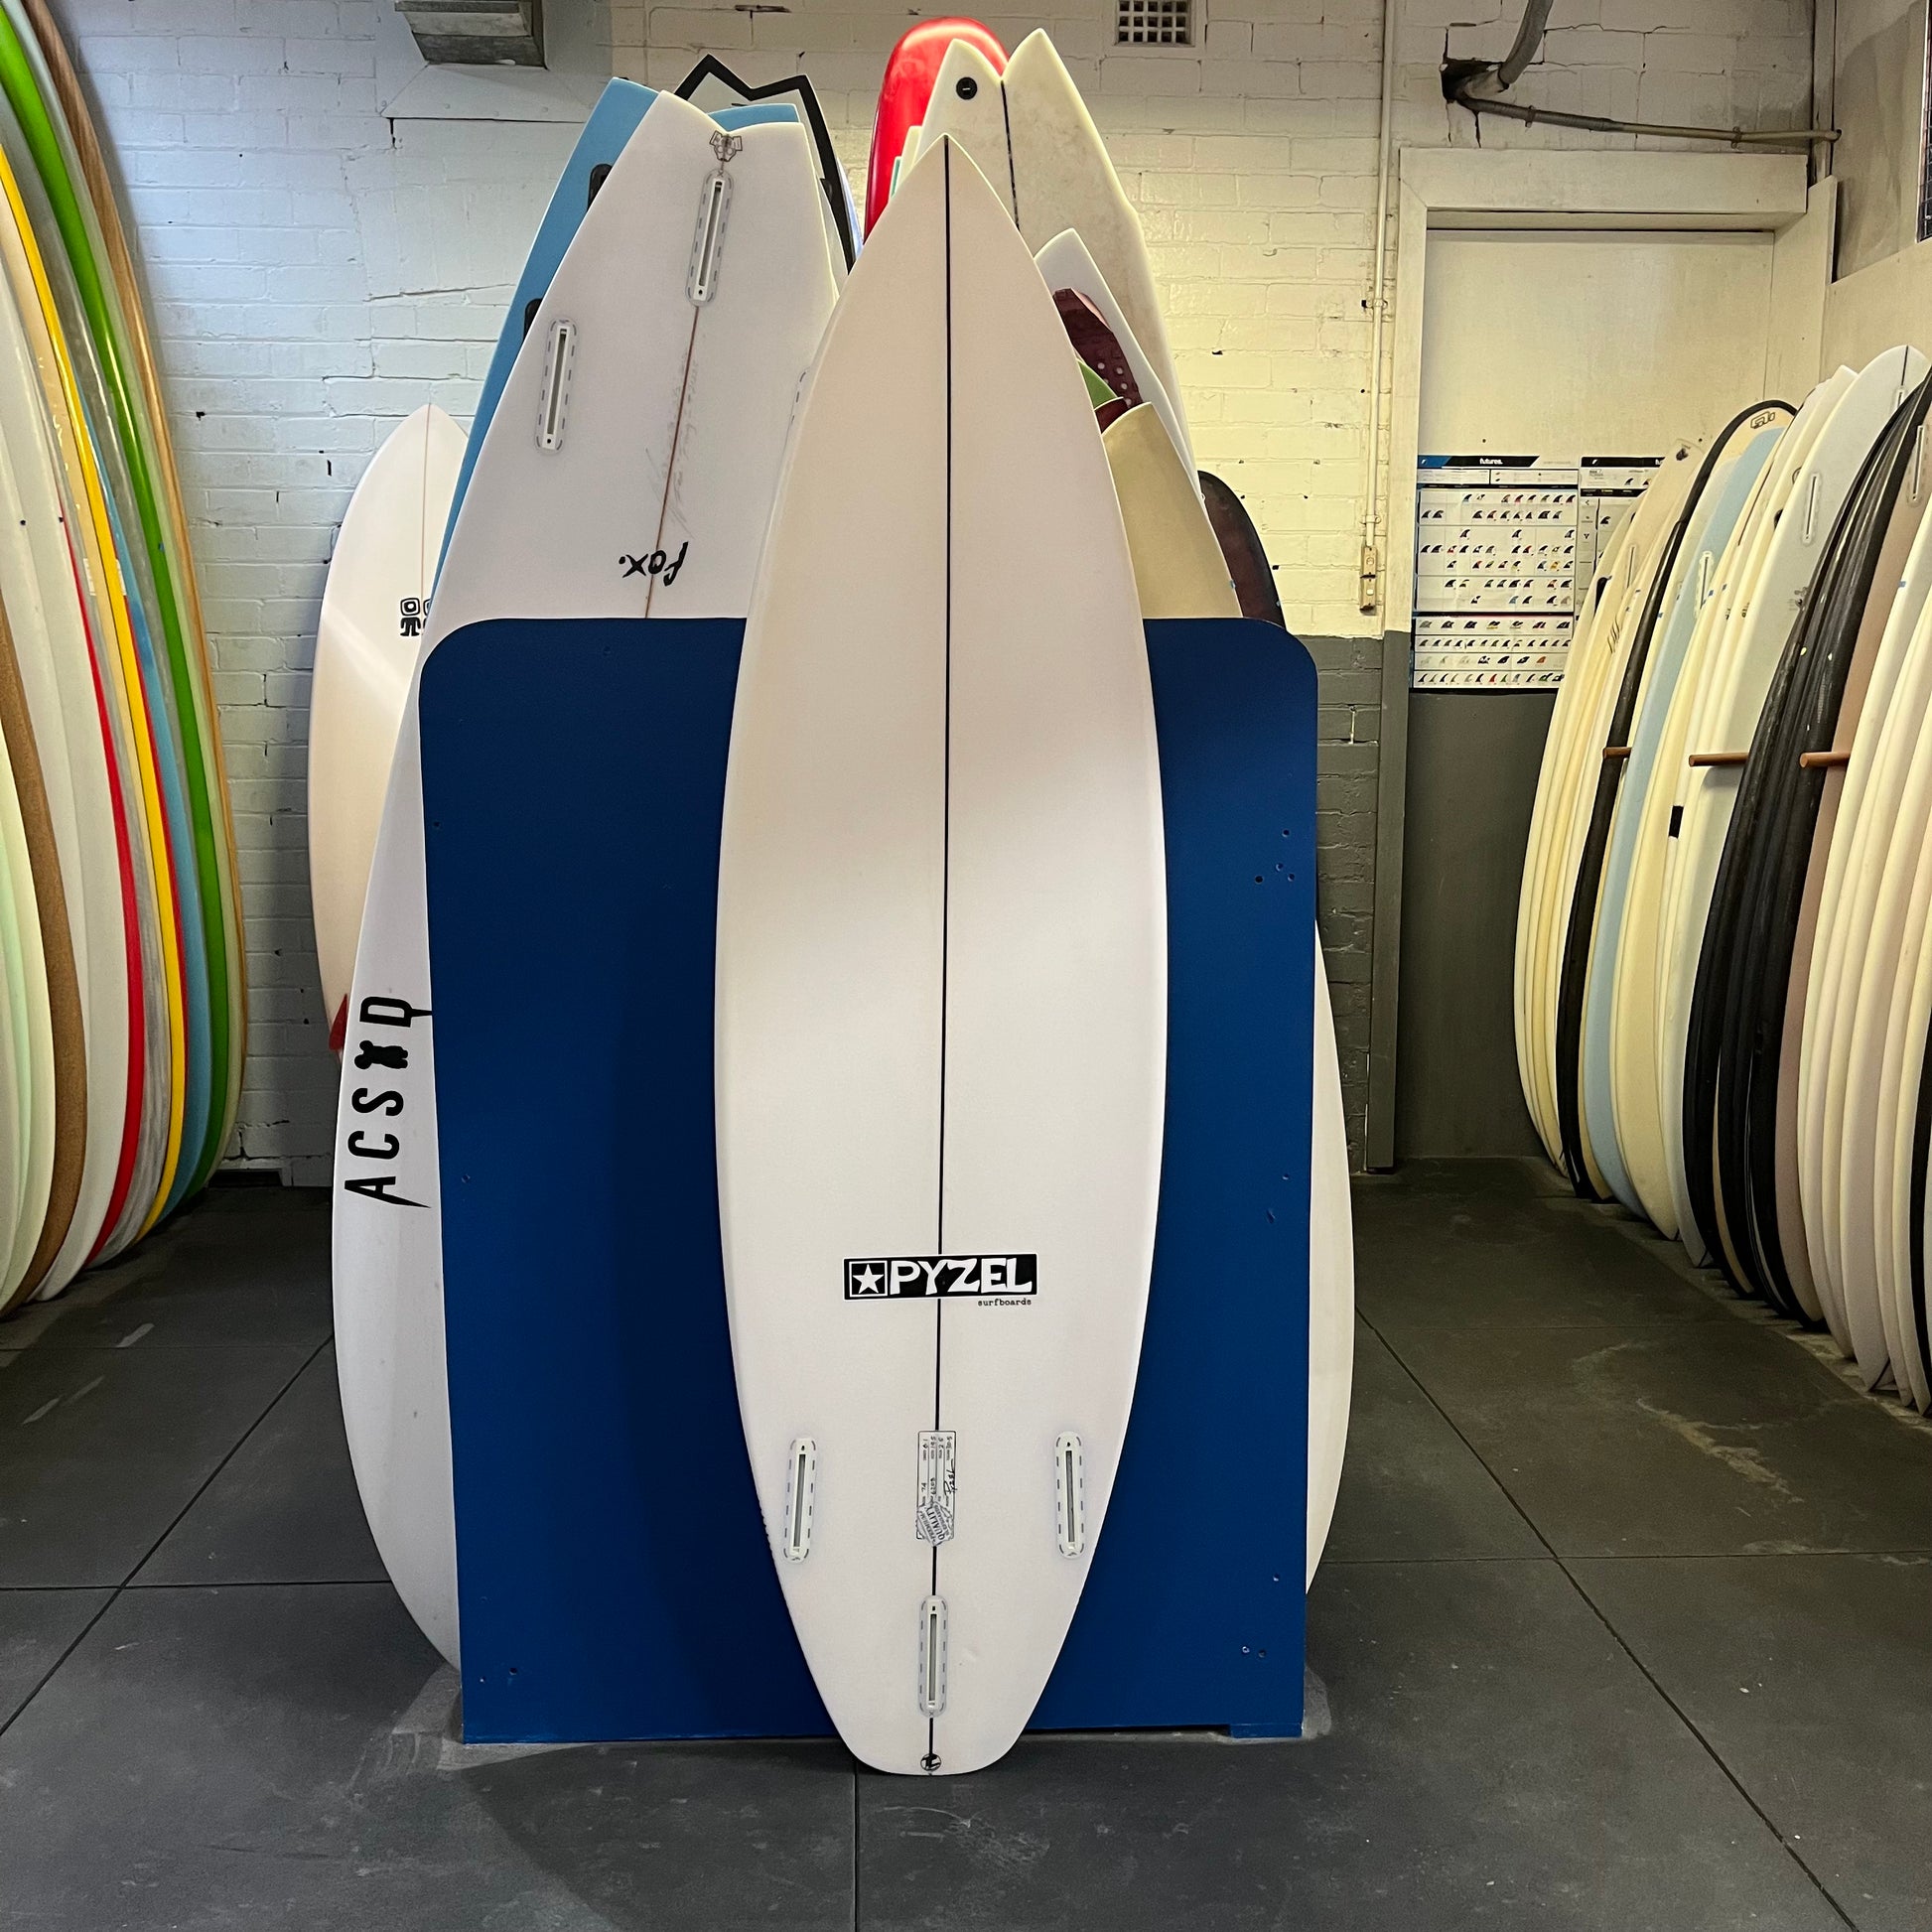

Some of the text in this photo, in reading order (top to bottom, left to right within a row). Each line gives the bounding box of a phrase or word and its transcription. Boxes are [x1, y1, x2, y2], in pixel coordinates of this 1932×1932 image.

[890, 1257, 1033, 1295] PYZEL
[977, 1298, 1033, 1307] surfboards
[925, 1506, 945, 1541] QUALITY
